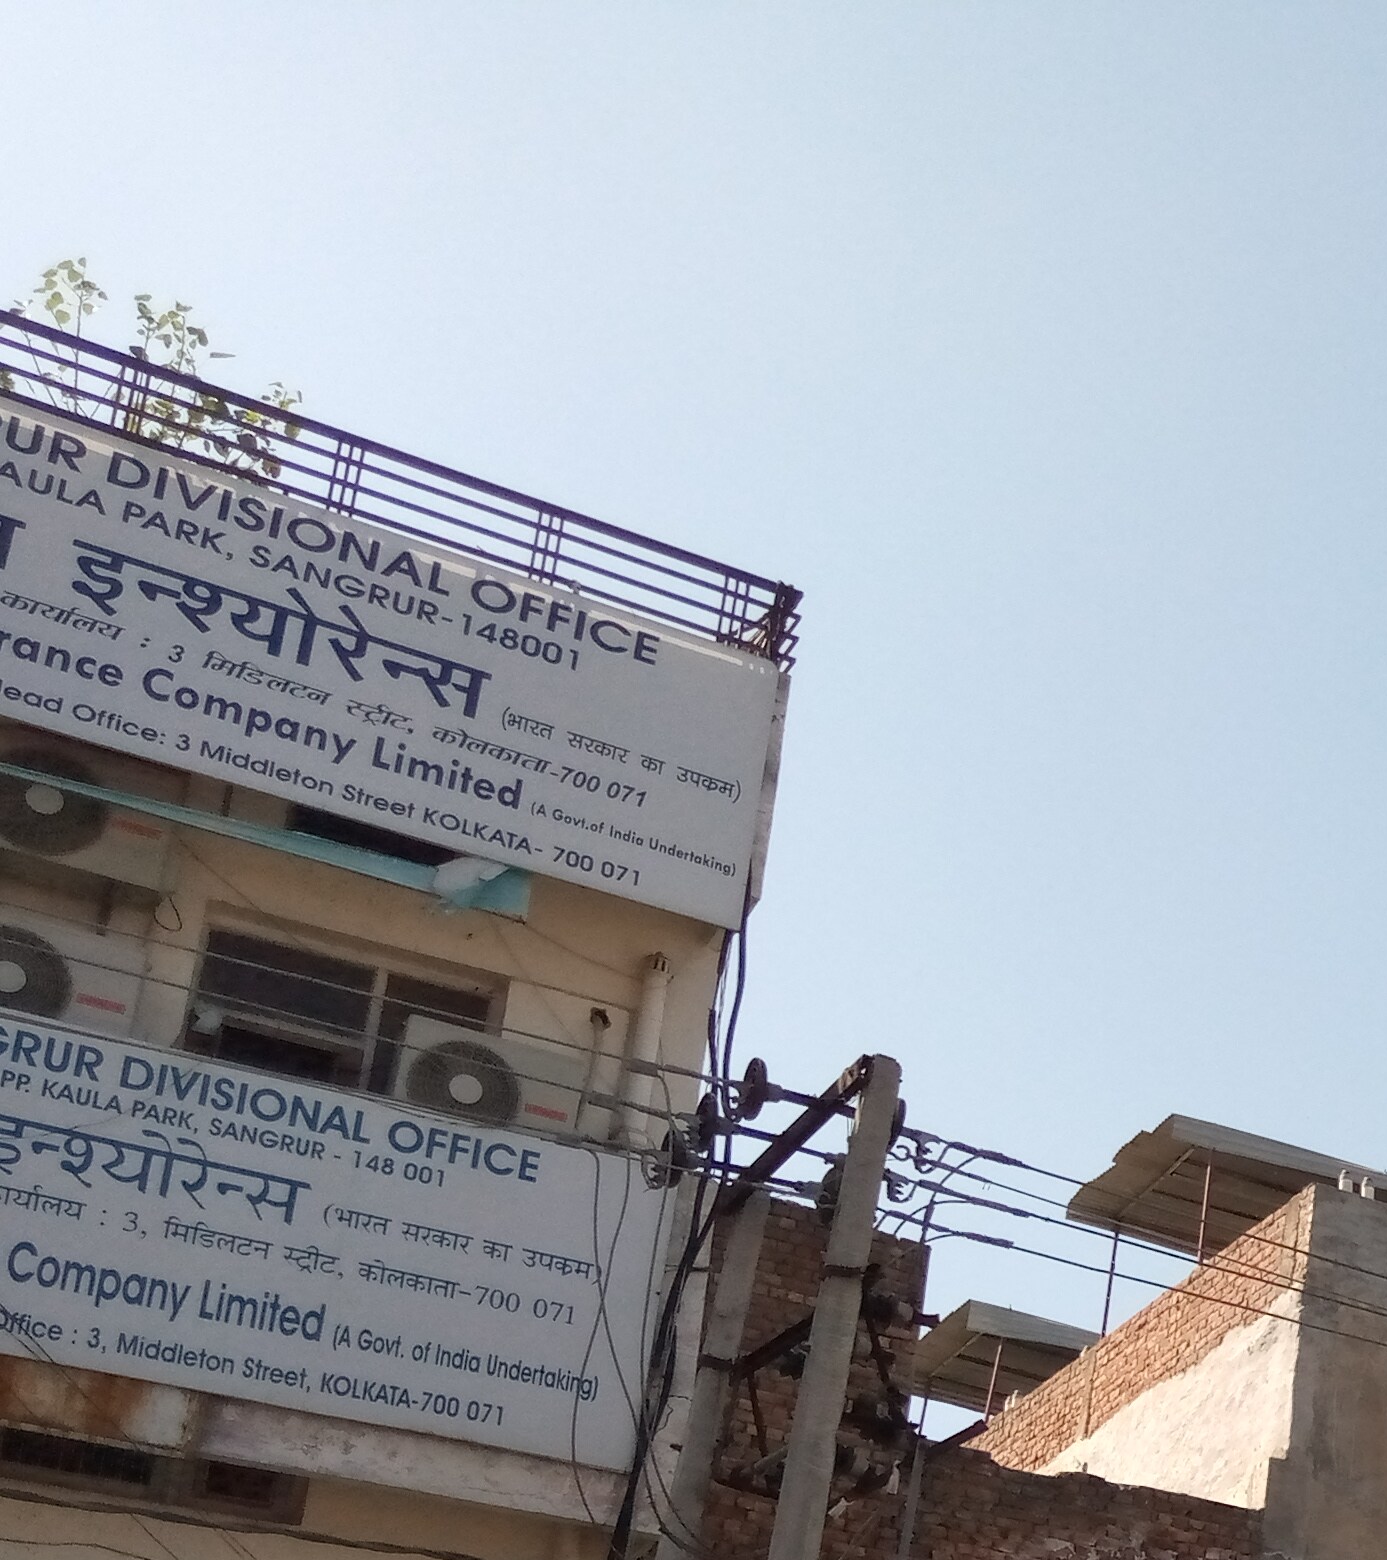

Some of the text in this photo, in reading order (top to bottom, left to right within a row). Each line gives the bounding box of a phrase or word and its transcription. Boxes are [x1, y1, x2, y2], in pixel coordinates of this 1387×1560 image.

[0, 415, 87, 473] UR
[107, 451, 450, 597] DIVISIONAL
[470, 579, 660, 666] OFFICE
[122, 501, 234, 561] PARK,
[249, 544, 580, 671] SANGRUR-148001
[72, 538, 492, 719] इन्श्योरेन्स
[0, 678, 64, 715] ead
[71, 698, 166, 745] Office:
[175, 732, 191, 752] 3
[199, 740, 335, 797] Middleton
[341, 782, 415, 820] Street
[552, 845, 594, 873] 700
[600, 859, 642, 887] 071
[142, 667, 357, 765] Company
[370, 736, 524, 810] Limited
[168, 644, 185, 664] 3
[201, 650, 332, 706] मिडिलटन
[606, 780, 647, 808] 071
[501, 705, 555, 741] (भारत
[566, 730, 631, 764] सरकार
[640, 752, 665, 776] का
[530, 801, 737, 878] (A India Undertaking)
[41, 1078, 123, 1115] KAULA
[131, 1099, 198, 1134] PARK,
[208, 1117, 325, 1161] SANGRUR
[353, 1150, 395, 1176] 148
[403, 1161, 445, 1188] 001
[119, 1055, 370, 1145] DIVISIONAL
[388, 1120, 541, 1184] OFFICE
[122, 1211, 147, 1239] 3,
[163, 1215, 274, 1260] मिडिलटन
[532, 1297, 576, 1325] 071
[322, 1203, 513, 1262] (भारत सरकार का
[7, 1240, 327, 1342] Company Limited
[87, 1326, 106, 1354] 3,
[116, 1331, 236, 1376] Middleton
[241, 1355, 312, 1394] Street,
[320, 1371, 460, 1418] KOLKATA-700
[466, 1400, 505, 1427] 071
[331, 1323, 600, 1404] (A Govt. of India Undertaking)
